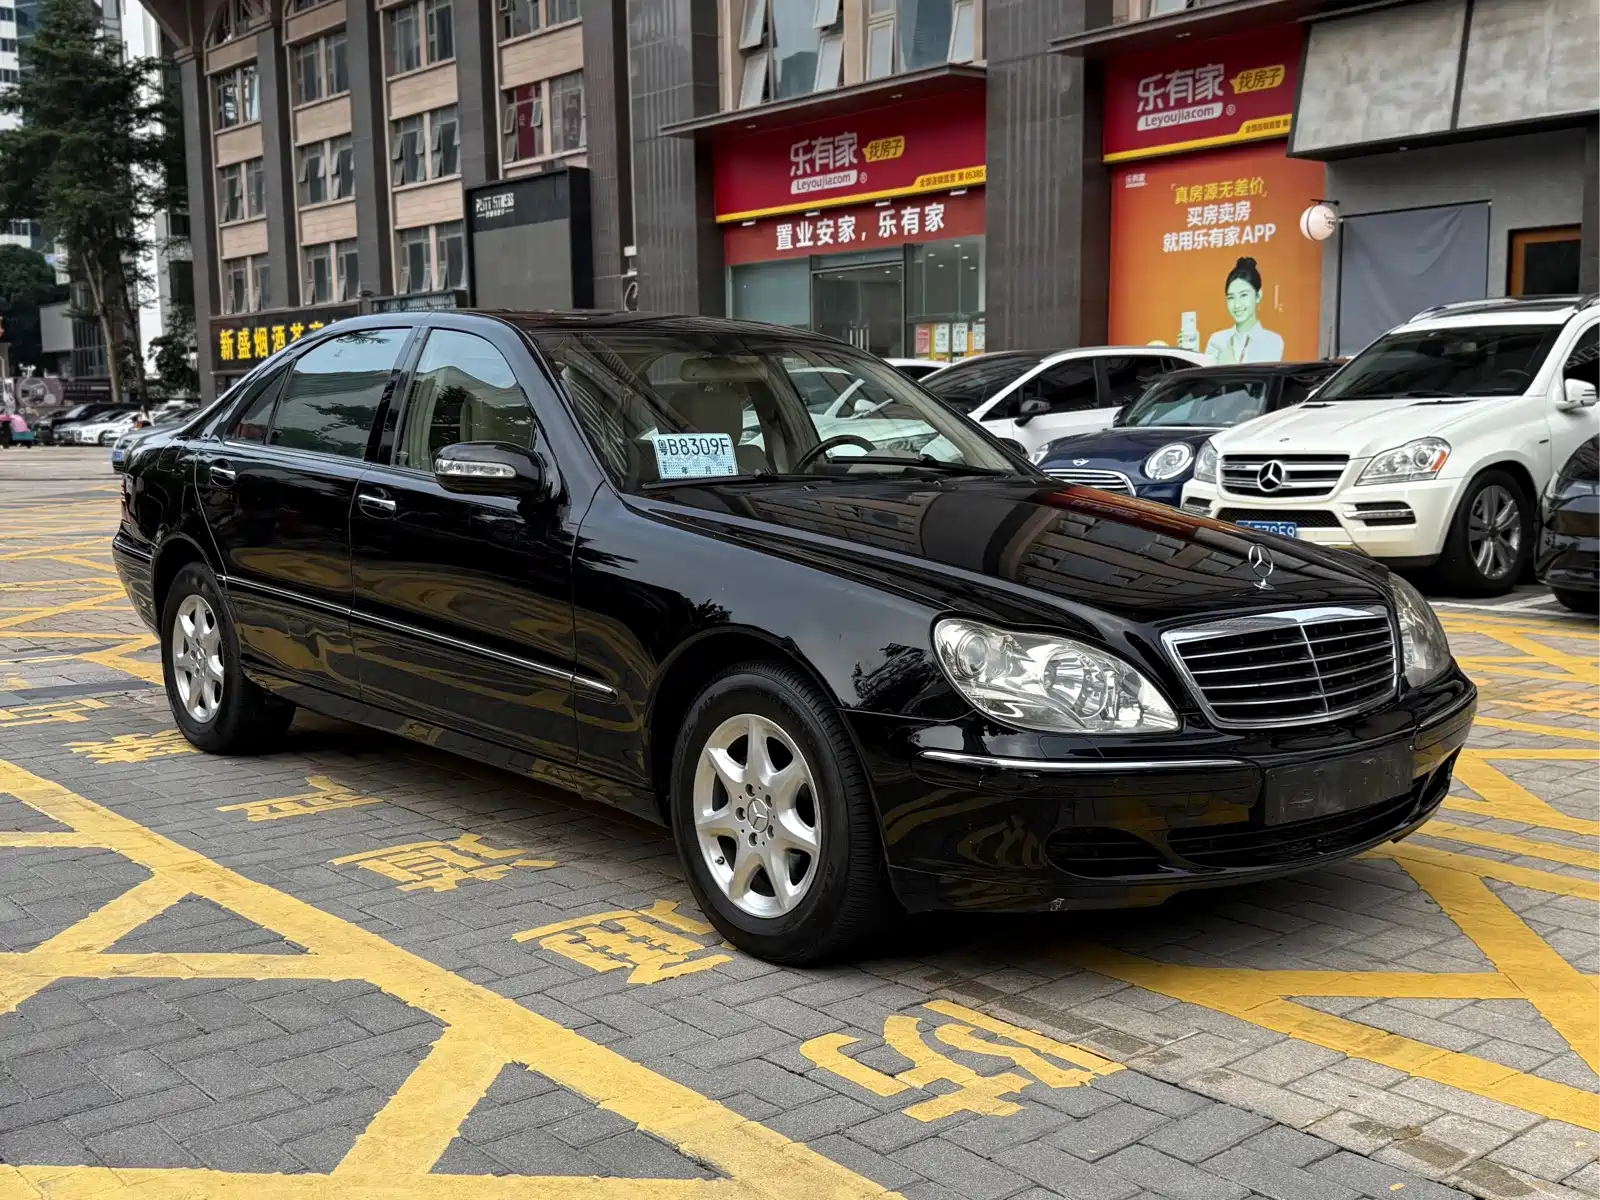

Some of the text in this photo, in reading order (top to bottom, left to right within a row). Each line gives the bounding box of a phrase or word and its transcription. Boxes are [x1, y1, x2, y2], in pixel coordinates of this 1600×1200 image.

[1137, 63, 1225, 113] 乐有家
[1238, 67, 1281, 91] 找房子
[790, 131, 858, 177] 乐有家
[868, 139, 903, 160] 找房子
[1186, 200, 1251, 227] 买房卖房
[657, 438, 729, 455] 粤B8309F
